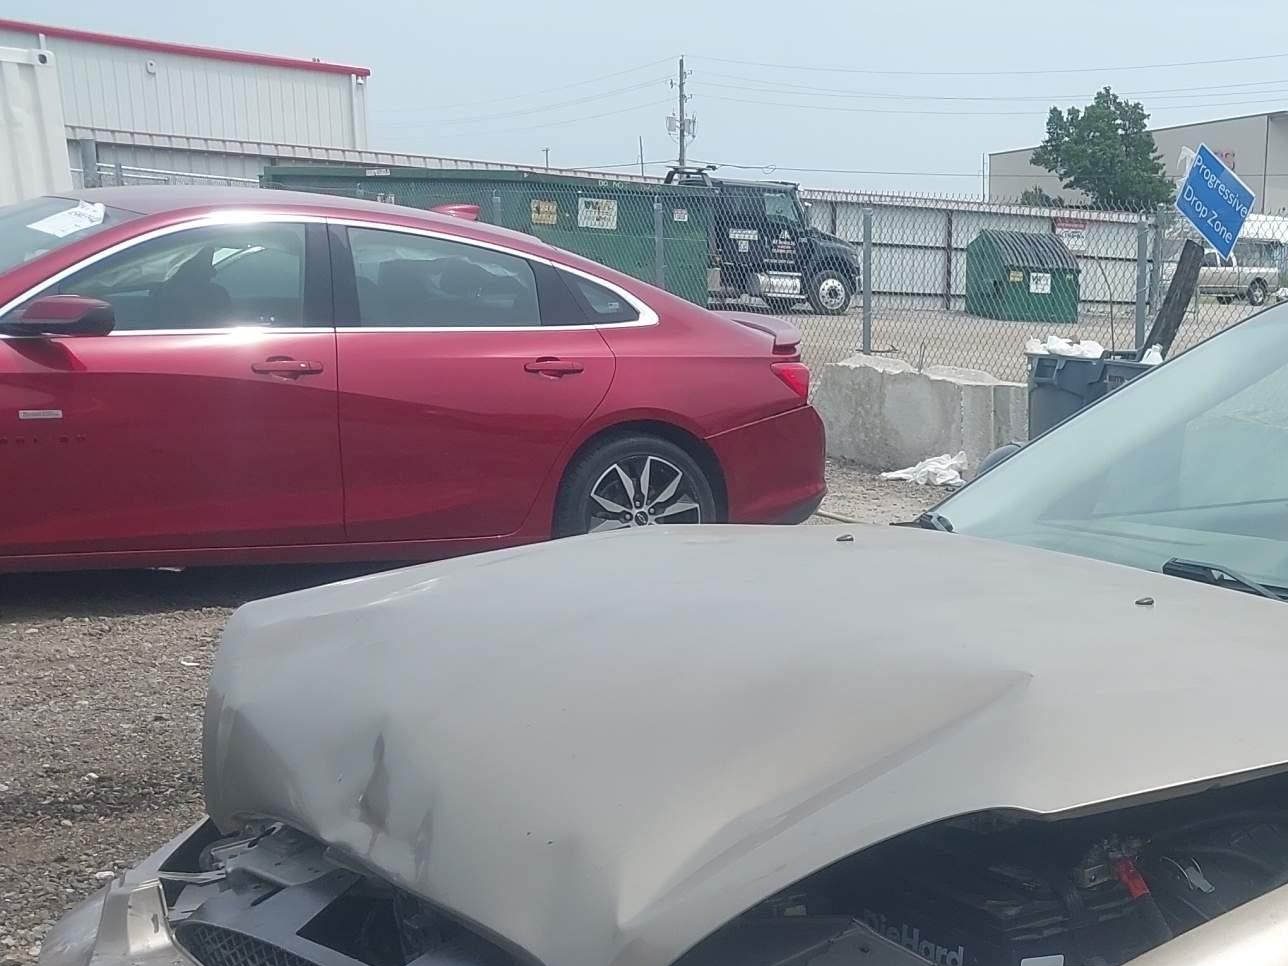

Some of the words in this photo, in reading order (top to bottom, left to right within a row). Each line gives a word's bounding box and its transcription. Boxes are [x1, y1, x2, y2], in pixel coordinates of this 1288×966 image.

[1183, 185, 1208, 218] Drop
[1206, 211, 1233, 243] Zone
[1194, 154, 1248, 218] Progressive
